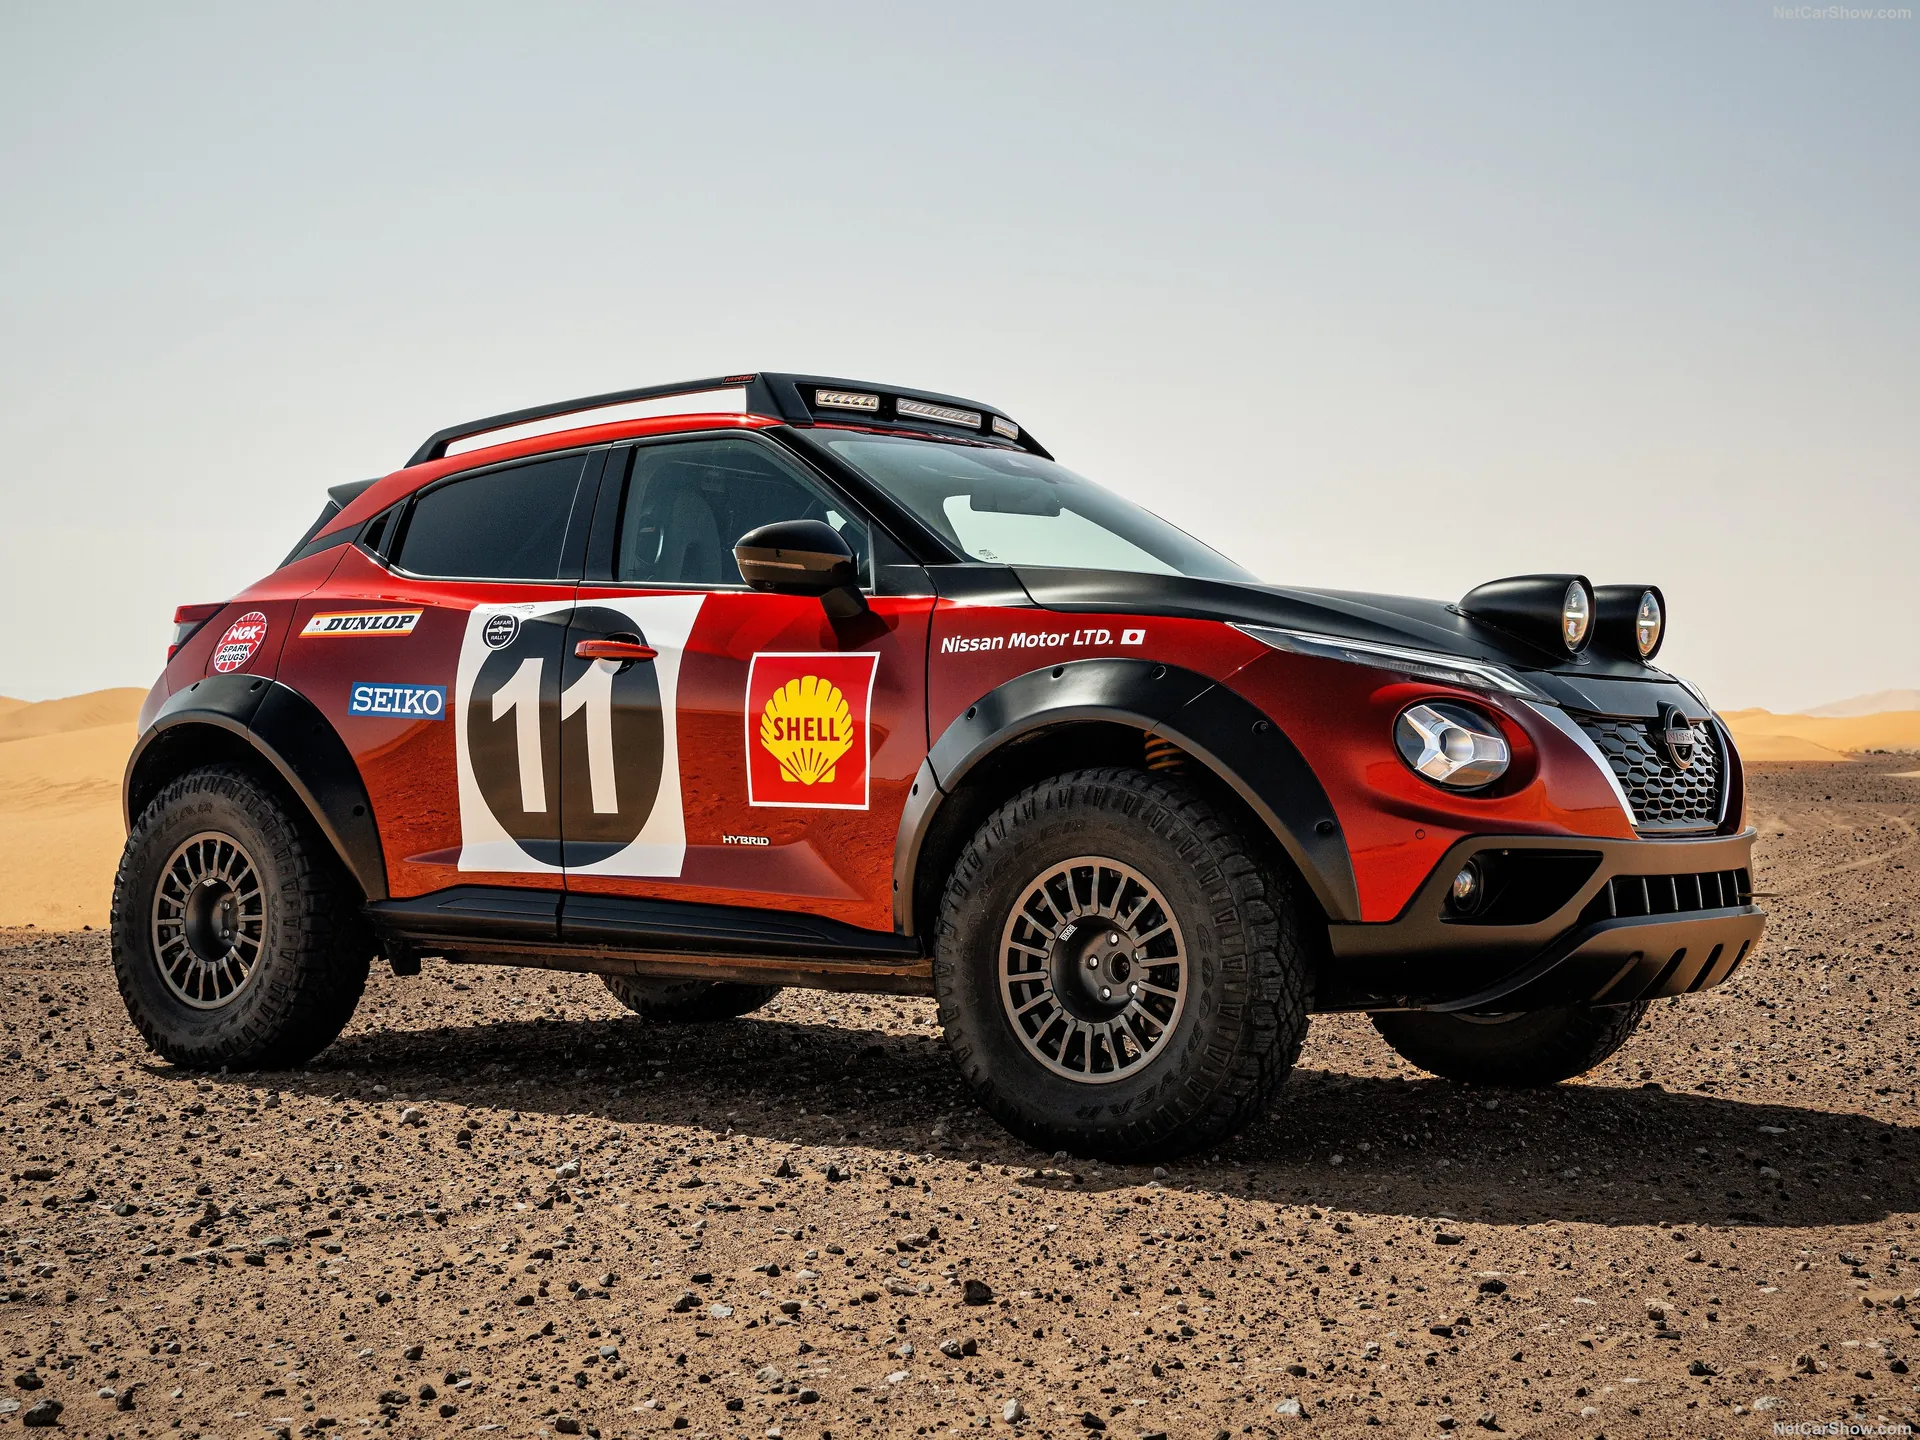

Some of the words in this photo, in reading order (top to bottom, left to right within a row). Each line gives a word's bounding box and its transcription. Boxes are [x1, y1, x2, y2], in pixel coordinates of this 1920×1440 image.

[324, 615, 415, 631] DUNLOP
[227, 625, 257, 641] NGK
[941, 635, 1004, 653] Nissan
[1008, 631, 1070, 649] Motor
[1073, 629, 1114, 645] LTD.
[222, 644, 250, 653] SPARK
[217, 653, 246, 662] PLUGS
[353, 686, 442, 716] SEIKO
[492, 657, 622, 813] 11
[773, 717, 840, 741] SHELL
[722, 835, 769, 846] HYBRID
